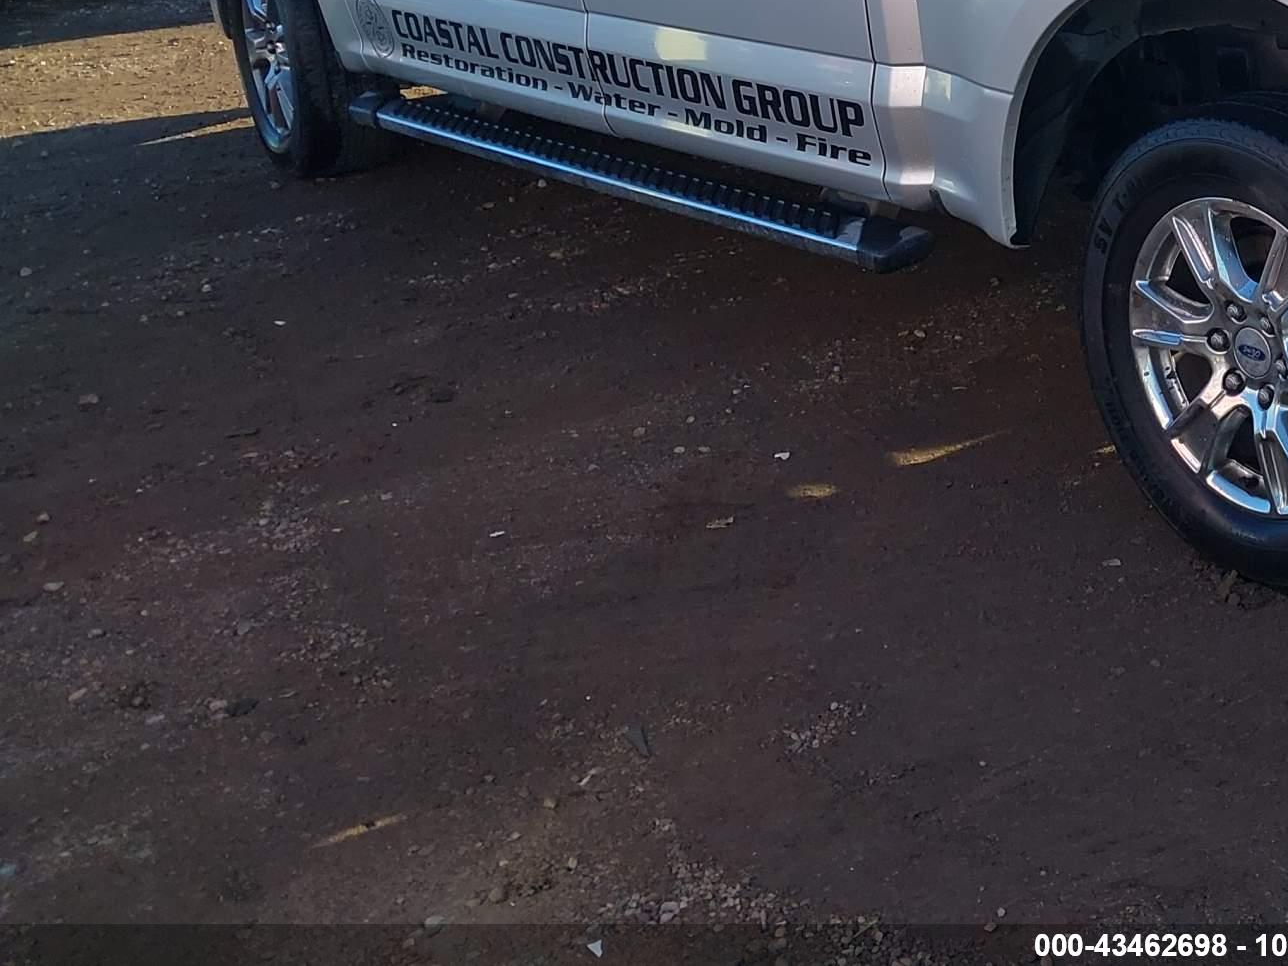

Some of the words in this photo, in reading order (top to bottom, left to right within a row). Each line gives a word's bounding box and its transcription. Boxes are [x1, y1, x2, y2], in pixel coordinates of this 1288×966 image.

[391, 9, 500, 60] COASTAL
[500, 32, 727, 110] CONSTRUCTION
[731, 78, 865, 137] GROUP
[400, 42, 549, 92] Restoration
[567, 81, 661, 117] Water
[684, 107, 768, 143] Mold
[796, 132, 872, 166] Fire
